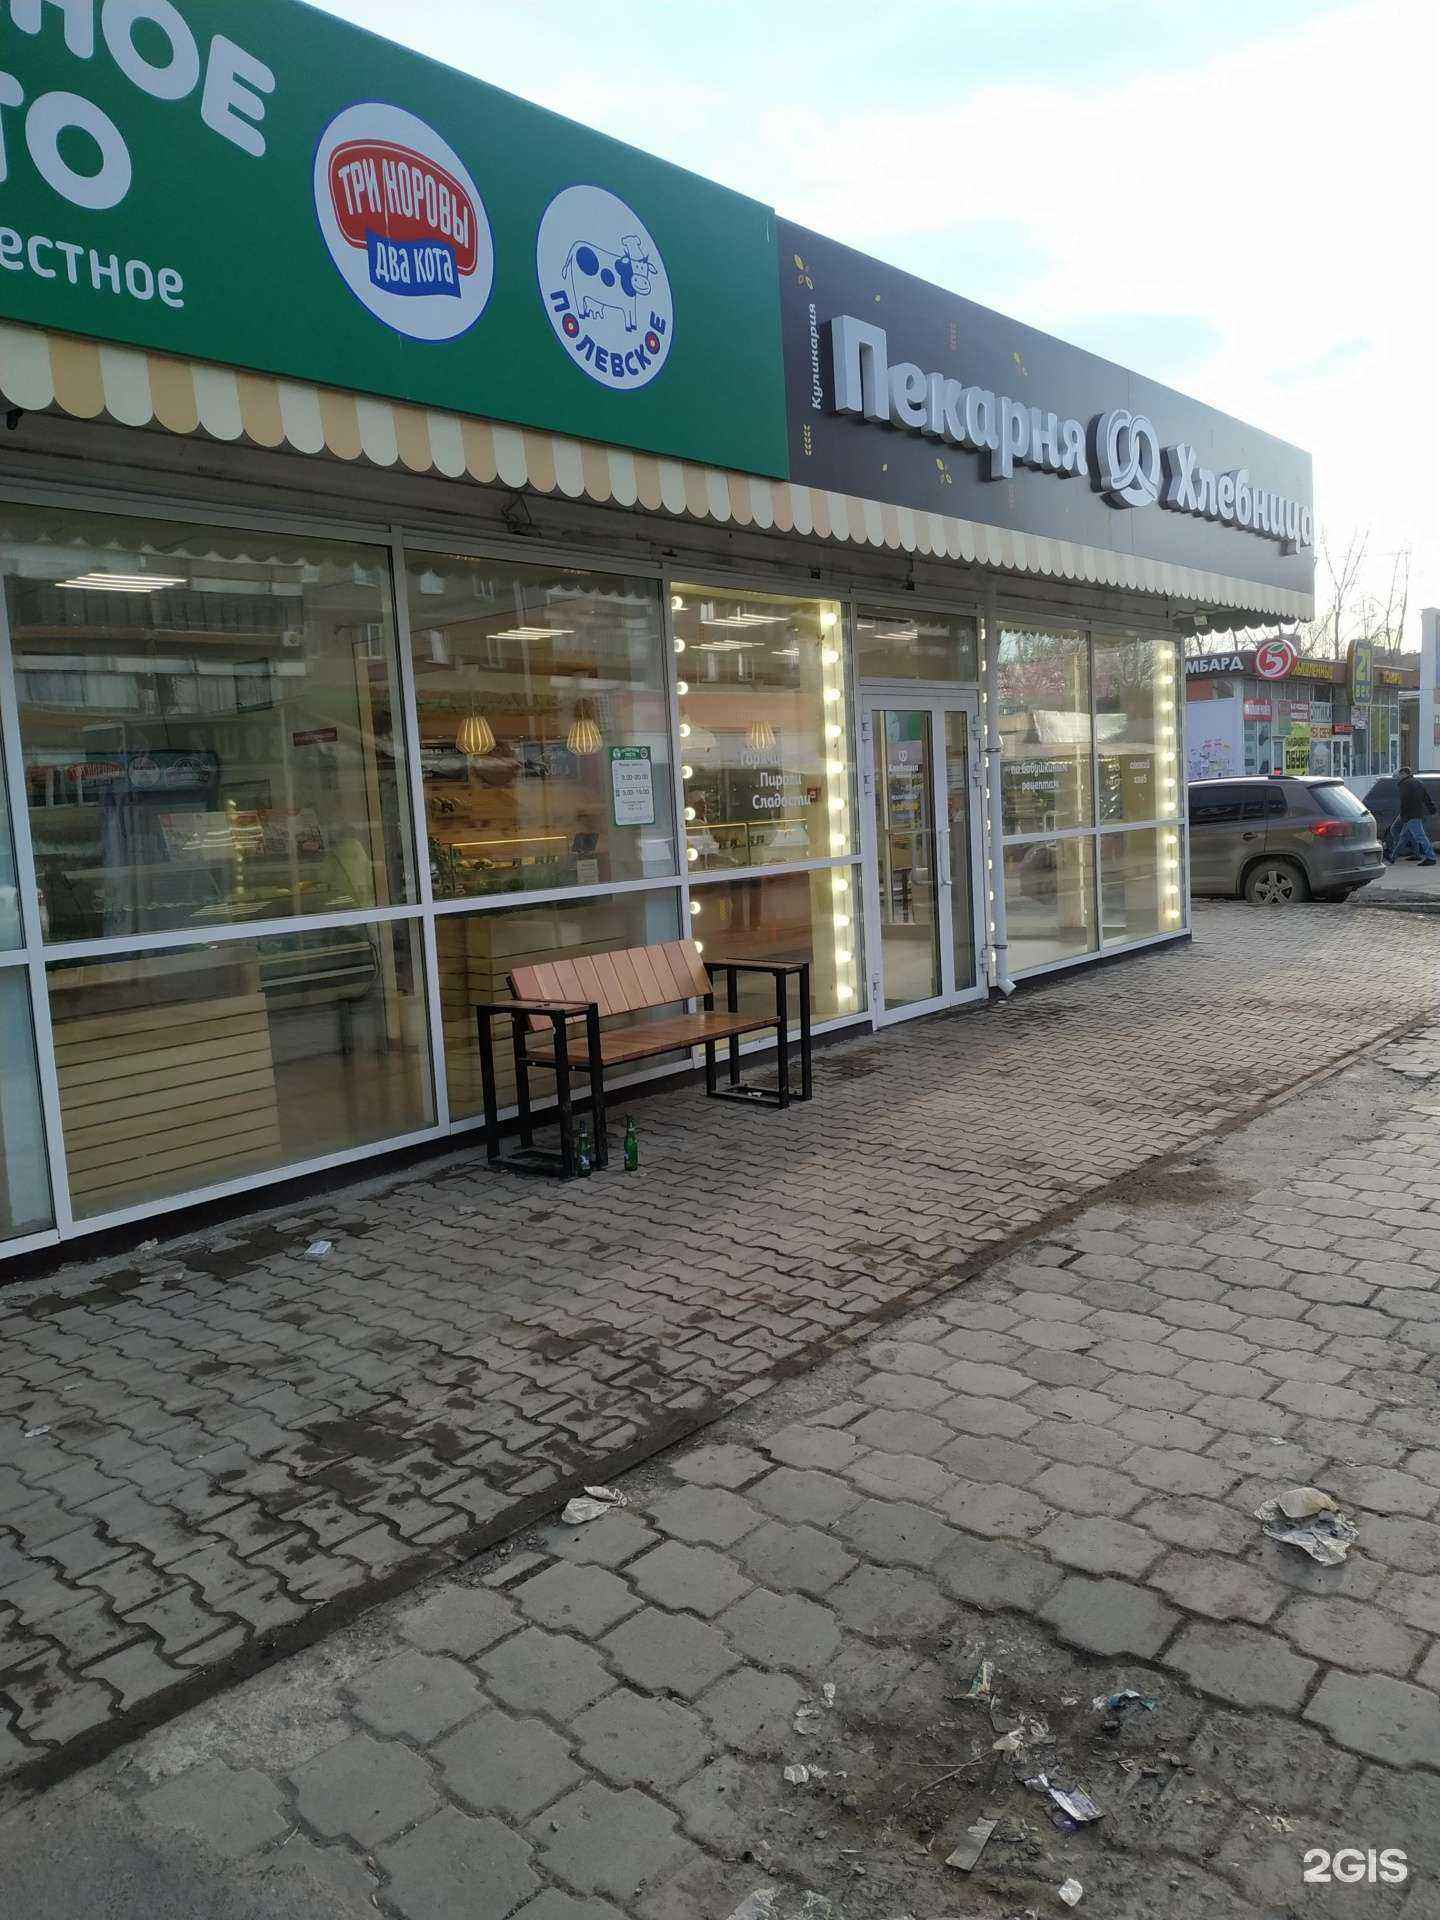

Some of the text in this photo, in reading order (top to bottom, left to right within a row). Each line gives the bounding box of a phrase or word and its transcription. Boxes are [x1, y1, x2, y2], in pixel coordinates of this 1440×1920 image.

[338, 158, 381, 216] ТРИ
[550, 290, 666, 378] ПОЛЕВСКОЕ
[808, 303, 824, 410] Кулинария
[832, 315, 1314, 555] Пекарня Хлебница
